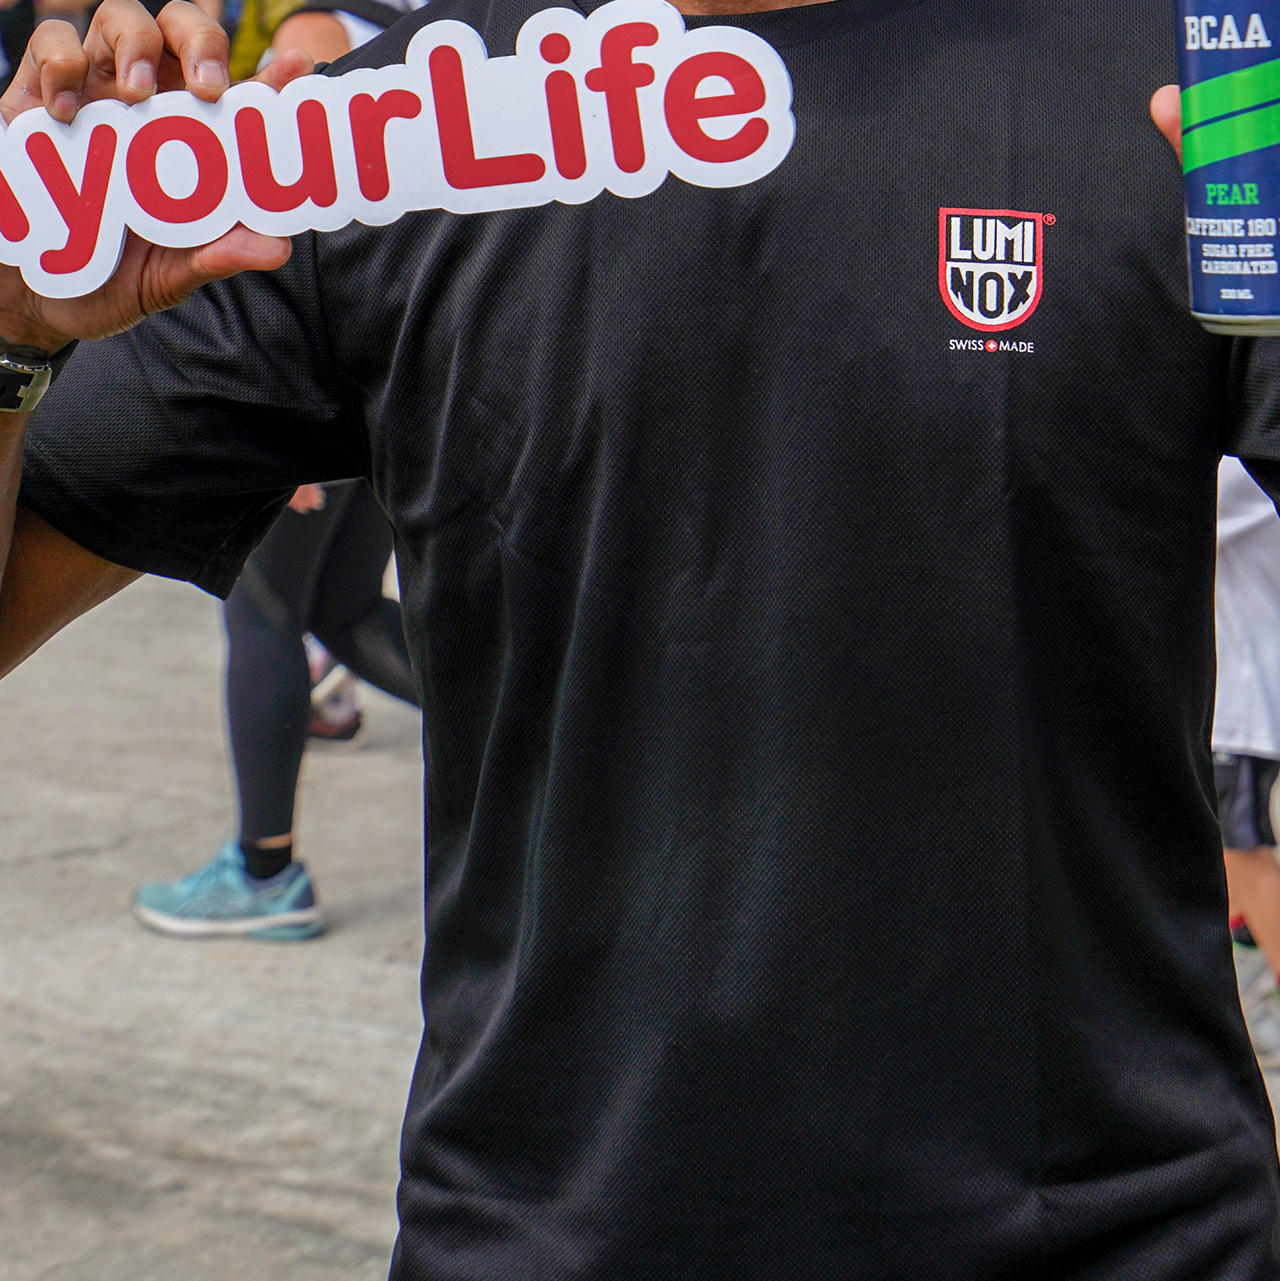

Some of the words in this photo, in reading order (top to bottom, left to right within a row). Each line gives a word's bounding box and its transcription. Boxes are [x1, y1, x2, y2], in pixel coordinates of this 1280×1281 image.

[1185, 13, 1272, 50] BCAA
[1206, 183, 1260, 205] PEAR
[1247, 218, 1277, 236] 180
[950, 217, 1034, 262] LUMI
[1202, 243, 1238, 257] SUGAR
[1238, 243, 1274, 257] FREE
[1201, 260, 1278, 274] CARBONATED
[950, 267, 1033, 319] NOX
[949, 339, 984, 351] SWISS
[999, 340, 1034, 353] MADE
